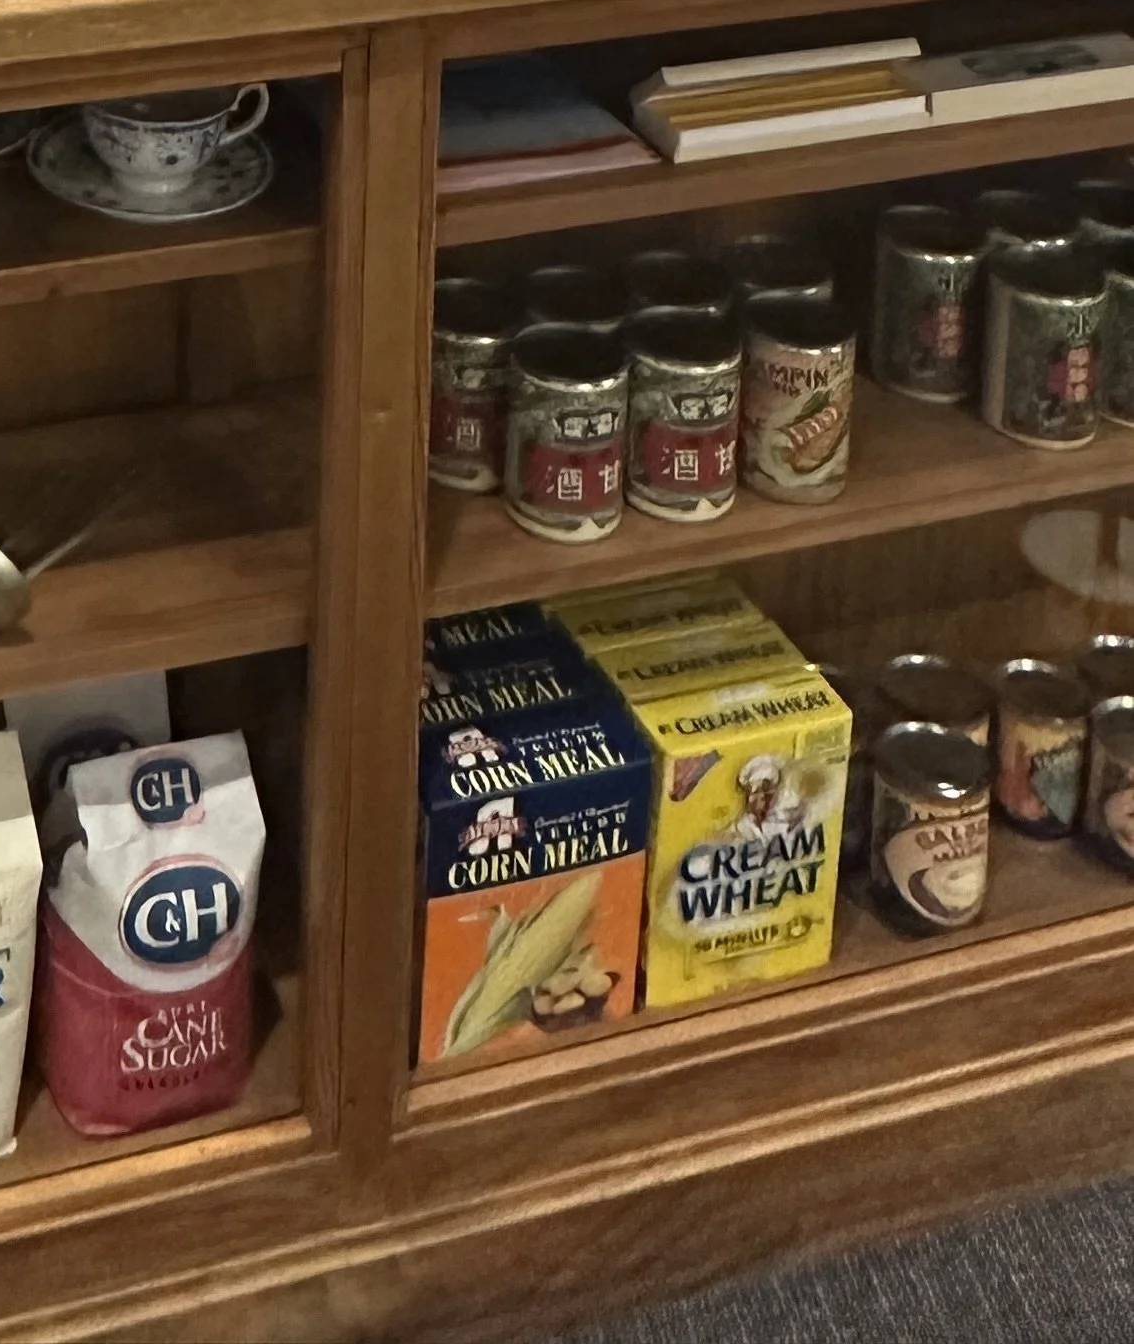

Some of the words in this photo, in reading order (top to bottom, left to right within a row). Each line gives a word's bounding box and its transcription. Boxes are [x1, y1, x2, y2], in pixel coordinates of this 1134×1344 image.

[420, 694, 483, 724] ORN
[489, 675, 573, 711] MEAL
[135, 767, 194, 811] C&H
[450, 761, 533, 800] CORN
[535, 742, 626, 783] MEAL
[447, 846, 533, 891] CORN
[543, 826, 629, 872] MEAL
[680, 822, 826, 883] CREAM
[134, 881, 229, 949] C&H
[679, 858, 826, 922] WHEAT
